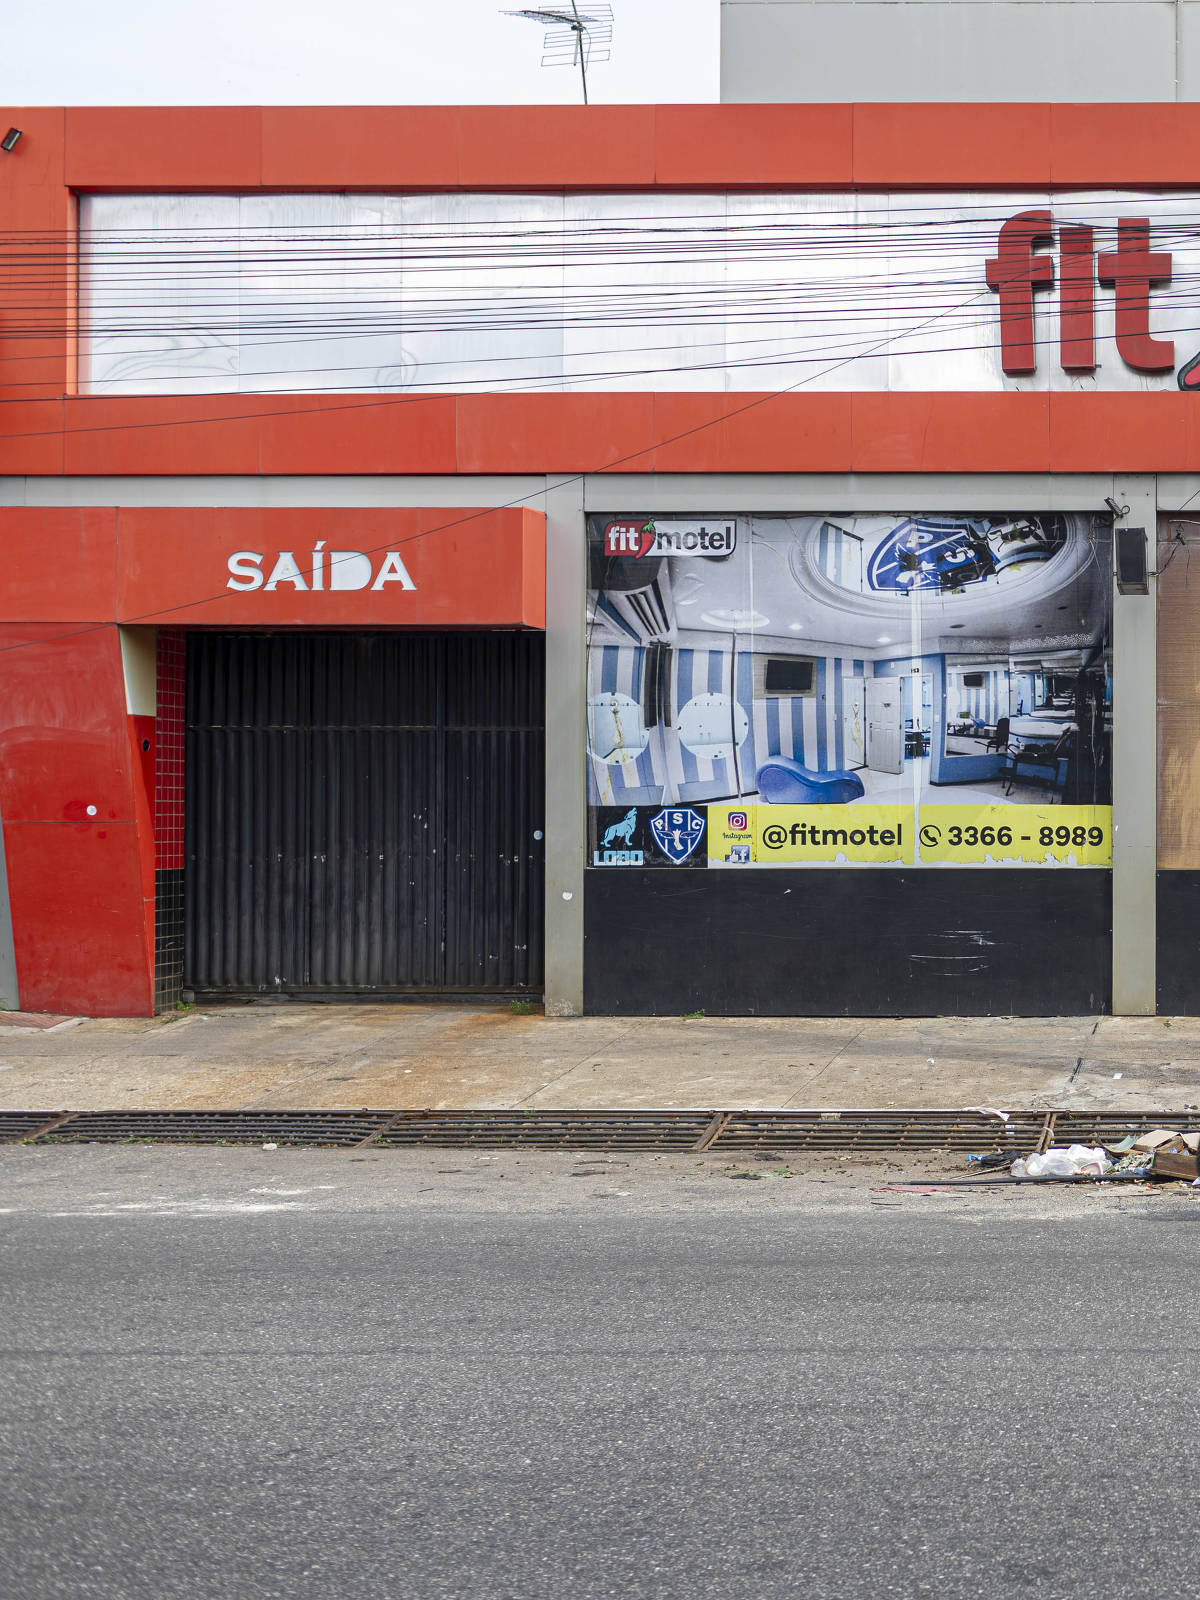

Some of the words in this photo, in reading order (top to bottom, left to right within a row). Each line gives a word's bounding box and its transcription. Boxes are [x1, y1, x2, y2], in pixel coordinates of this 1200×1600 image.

[985, 209, 1176, 375] fit
[608, 525, 640, 552] fit
[656, 526, 732, 551] motel
[226, 540, 418, 592] SAÍDA
[722, 832, 753, 841] Instagram
[762, 822, 903, 850] @fitmotel
[947, 825, 1014, 847] 3366
[1038, 824, 1105, 847] 8989
